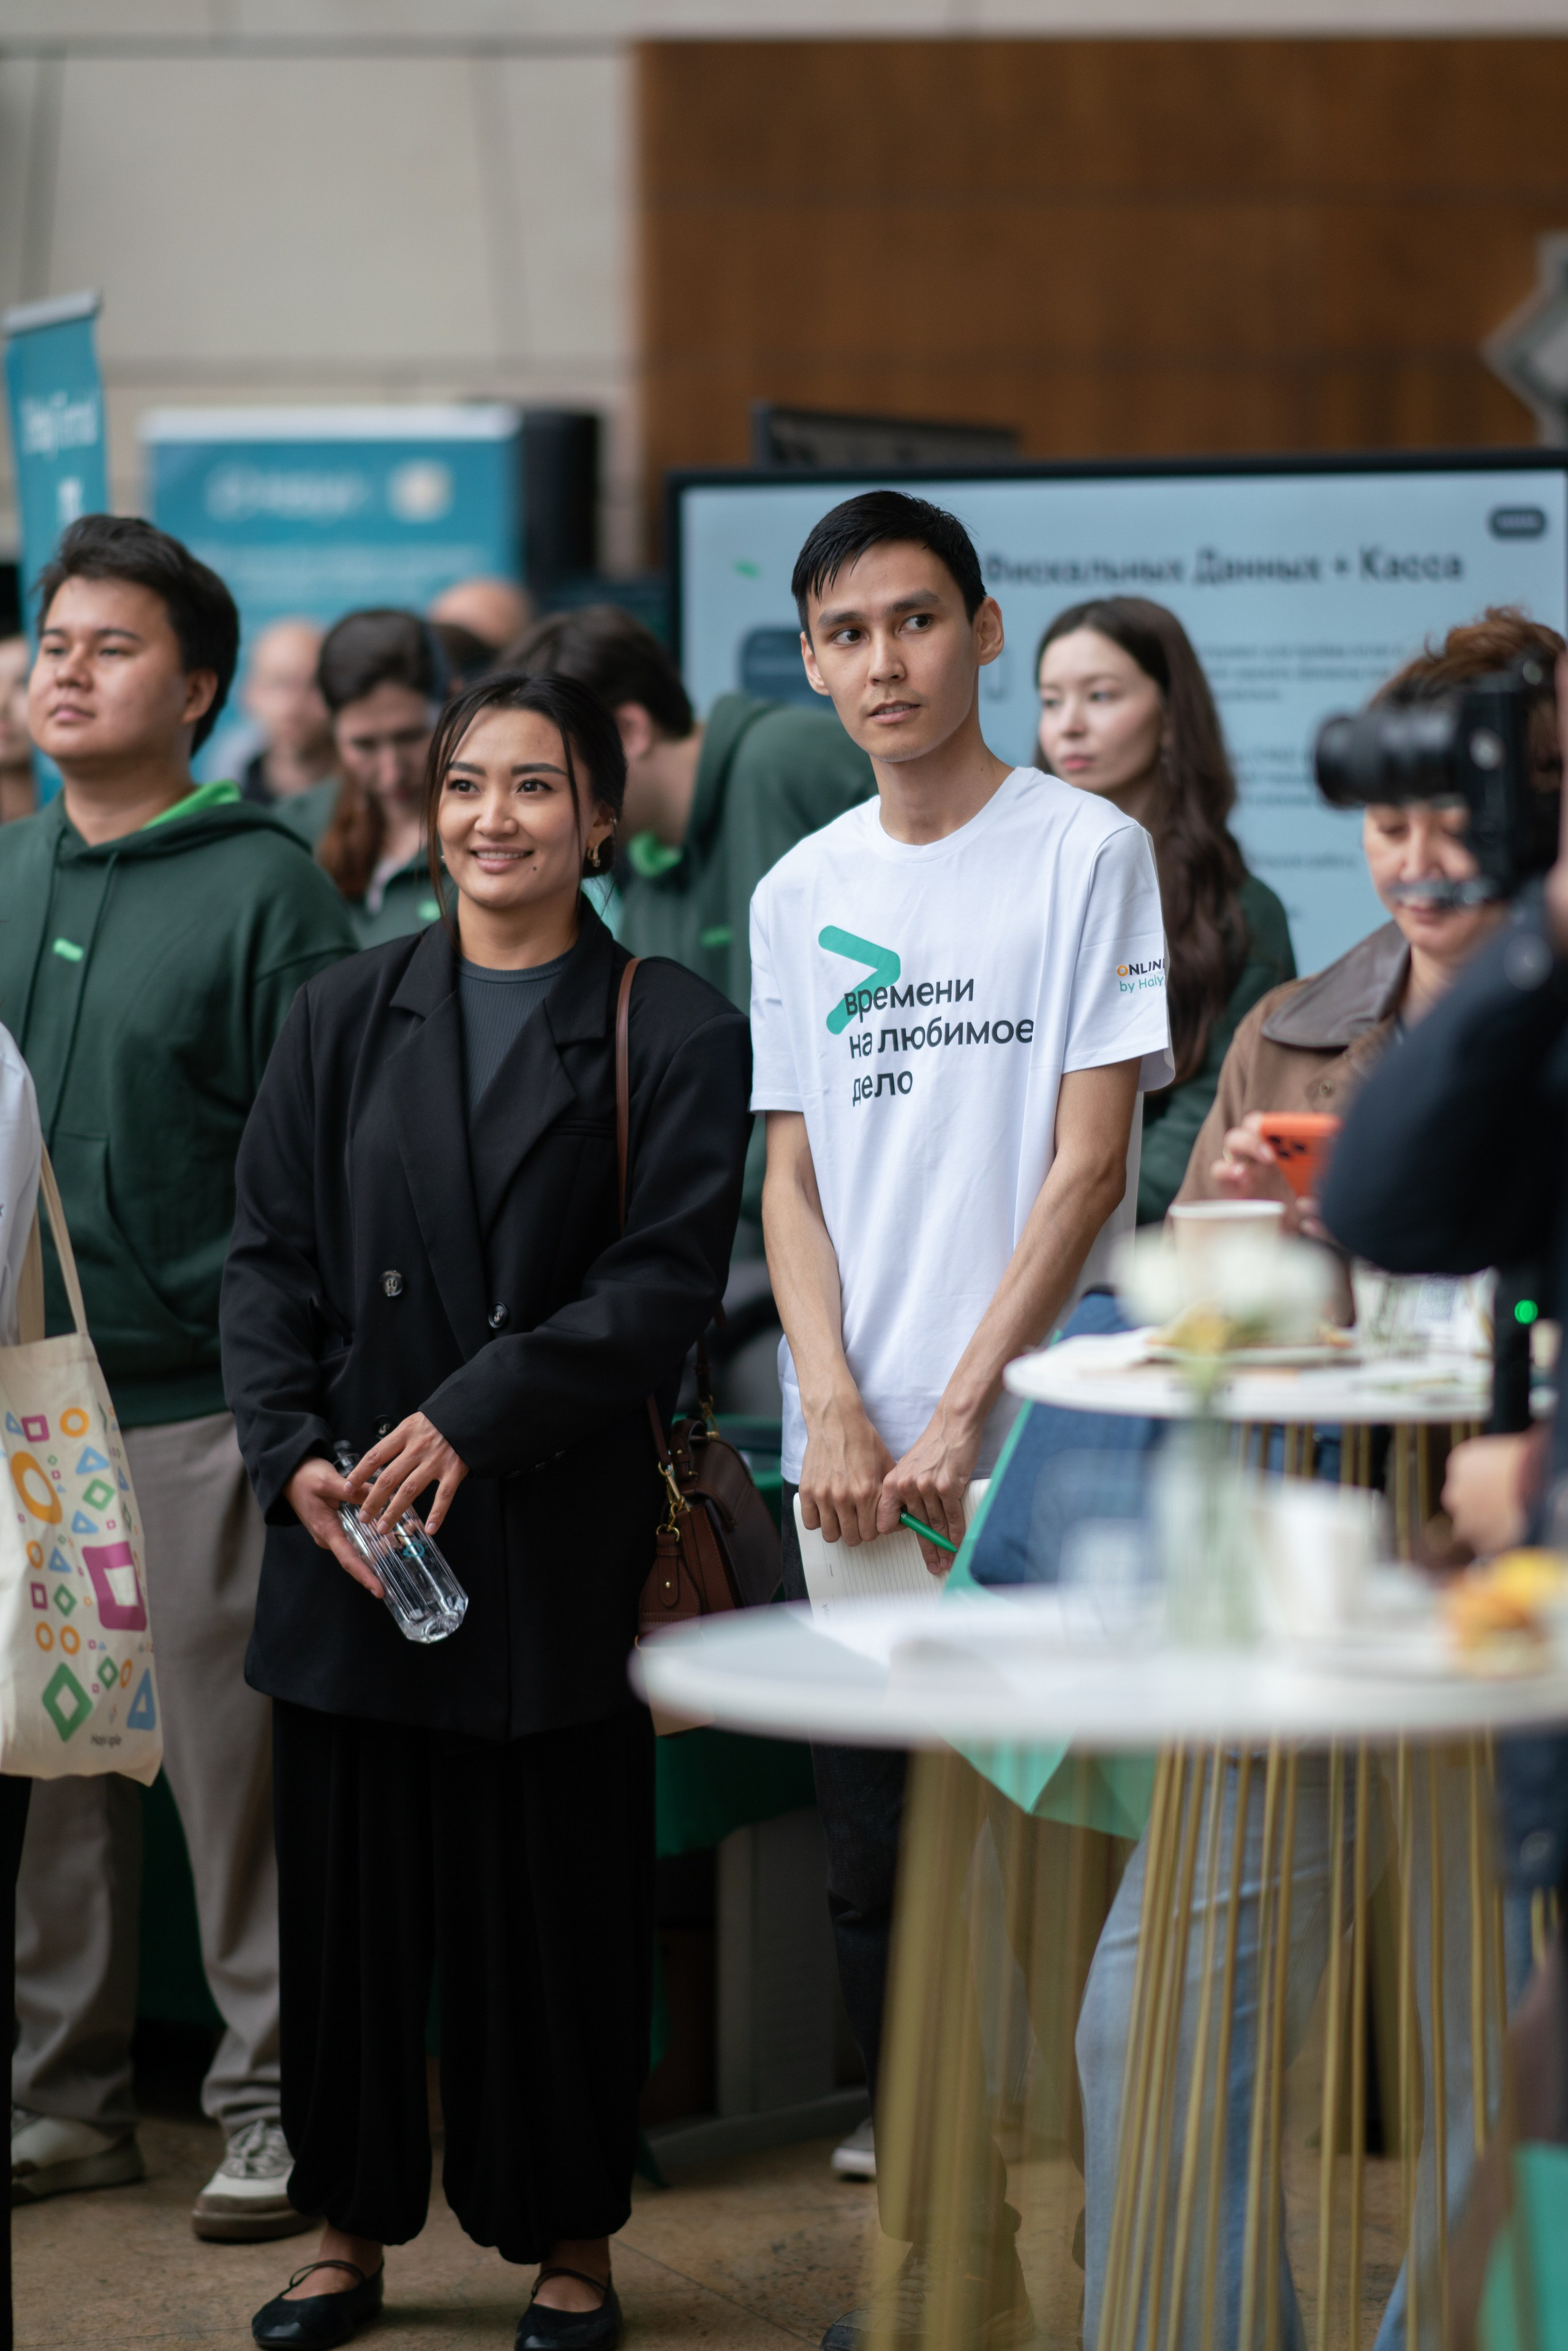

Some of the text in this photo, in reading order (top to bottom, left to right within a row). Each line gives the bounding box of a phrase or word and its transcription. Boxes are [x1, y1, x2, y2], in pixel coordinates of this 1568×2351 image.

[1359, 546, 1465, 581] Касса
[844, 978, 974, 1023] времени
[1119, 981, 1135, 994] by
[849, 1016, 1034, 1059] на любимое
[852, 1070, 913, 1107] дело
